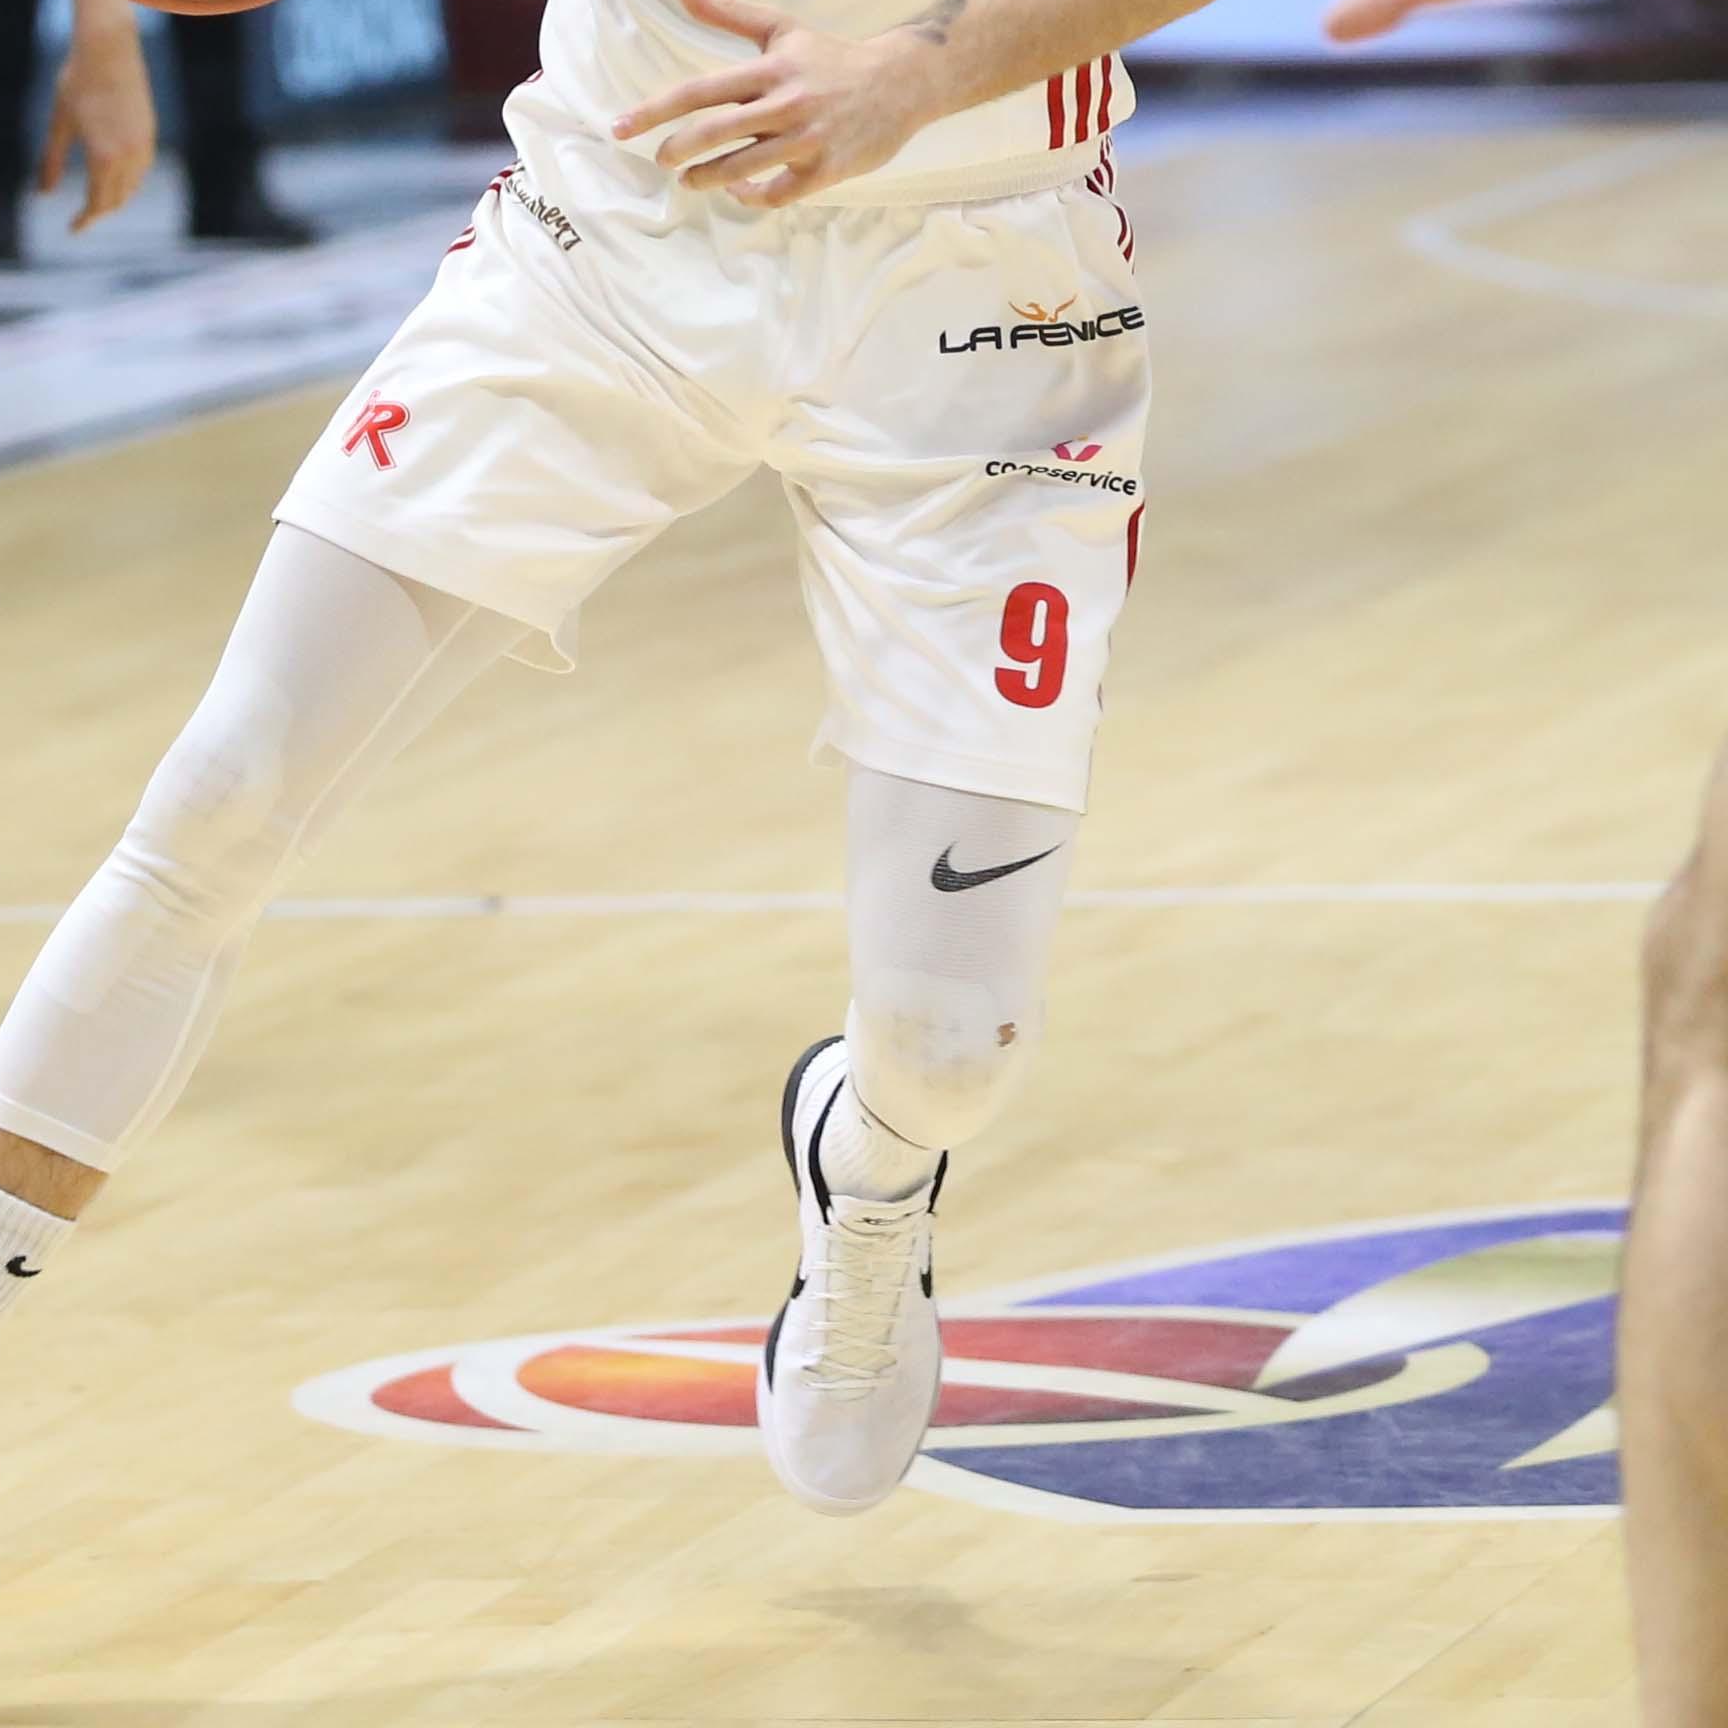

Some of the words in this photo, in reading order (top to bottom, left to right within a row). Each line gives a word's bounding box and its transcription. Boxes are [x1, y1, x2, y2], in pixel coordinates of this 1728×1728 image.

[939, 325, 1003, 354] LA
[1009, 306, 1145, 349] FENICE
[993, 580, 1071, 710] 9
